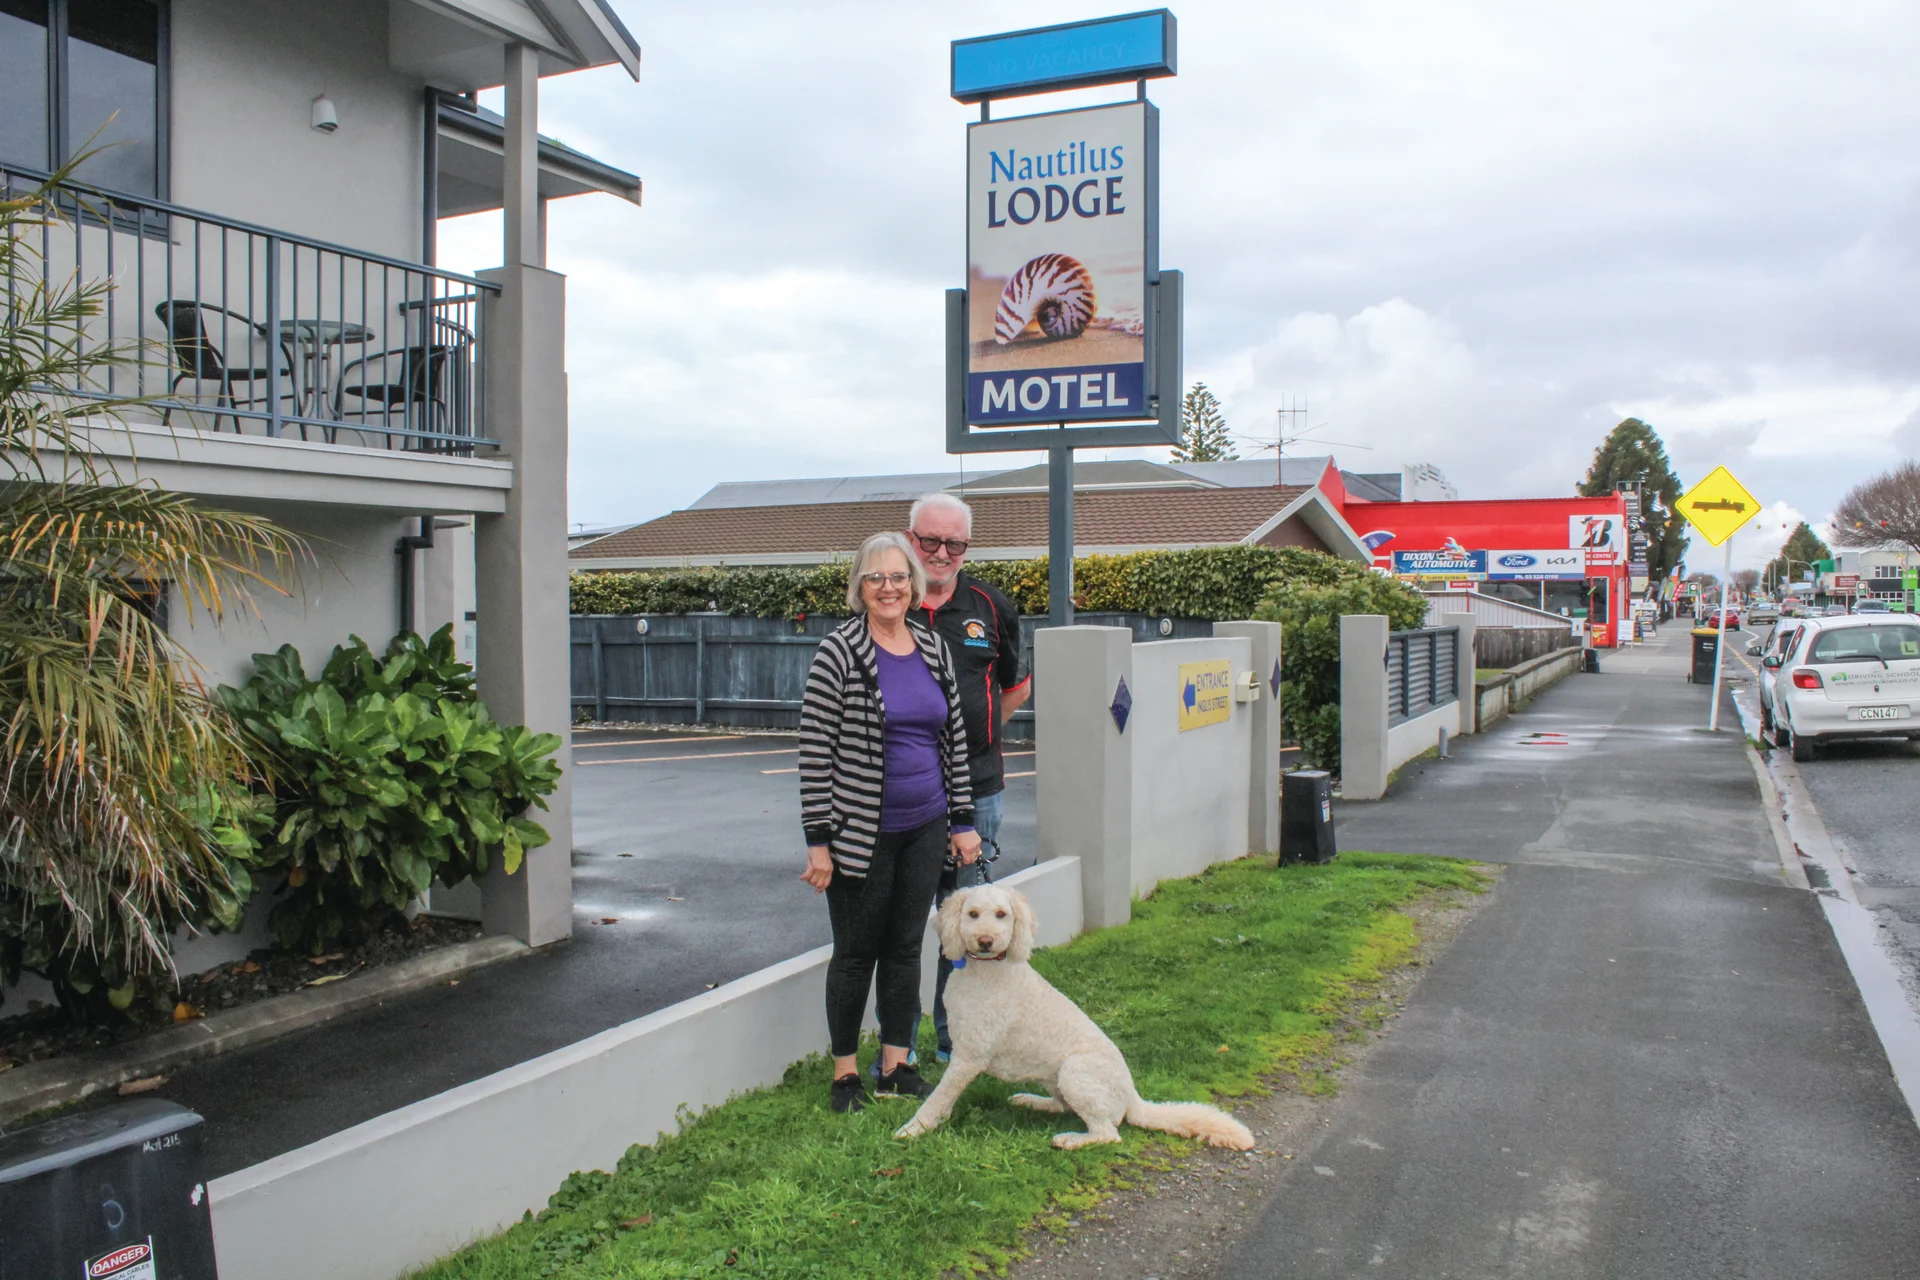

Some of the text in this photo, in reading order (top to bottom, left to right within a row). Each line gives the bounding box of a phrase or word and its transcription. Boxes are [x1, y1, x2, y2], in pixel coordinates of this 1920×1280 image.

[988, 41, 1127, 76] NO VACANCY
[989, 141, 1124, 184] Nautilus
[988, 176, 1126, 229] LODGE
[981, 372, 1129, 414] MOTEL
[1402, 552, 1436, 561] DIXON
[1410, 559, 1478, 568] AUTOMOTIVE
[1504, 555, 1577, 566] Ford KIA
[1196, 670, 1229, 692] ENTRANCE
[1848, 672, 1883, 680] DRIVING
[1197, 695, 1228, 714] INGLIS STREET
[1860, 708, 1897, 719] CCN147
[94, 1246, 145, 1274] DANGER
[127, 1263, 150, 1276] CABLES
